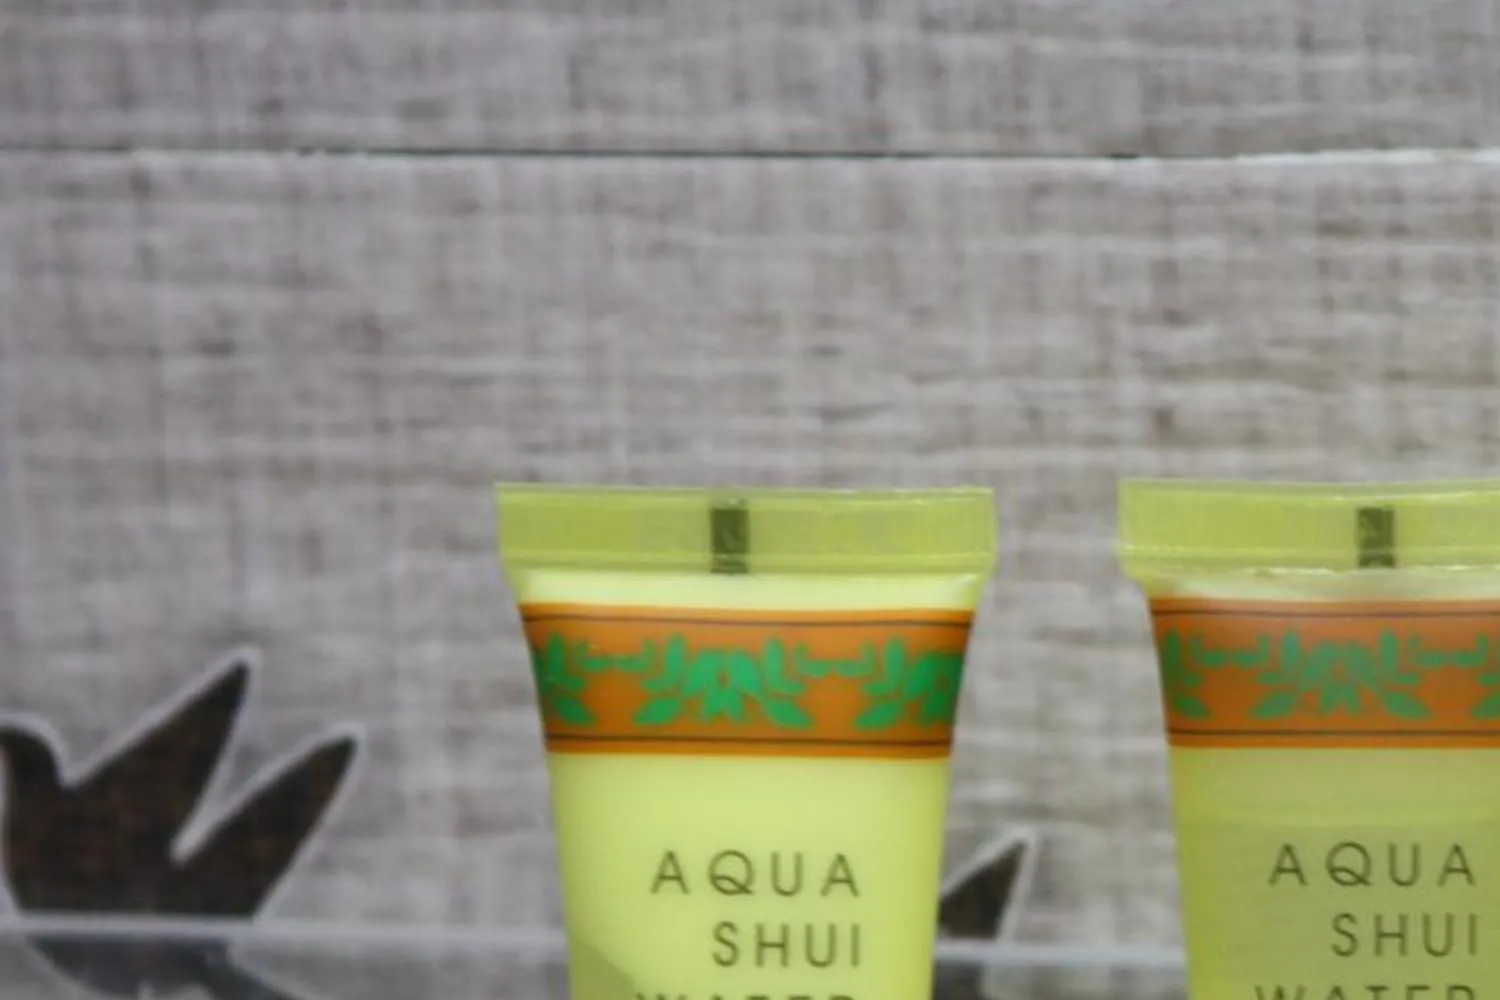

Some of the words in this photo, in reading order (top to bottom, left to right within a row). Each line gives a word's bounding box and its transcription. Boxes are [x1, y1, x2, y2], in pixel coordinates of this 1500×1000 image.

[651, 849, 860, 898] AQUA
[1268, 841, 1475, 888] AQUA
[711, 920, 860, 969] SHUI
[1331, 912, 1477, 958] SHUI
